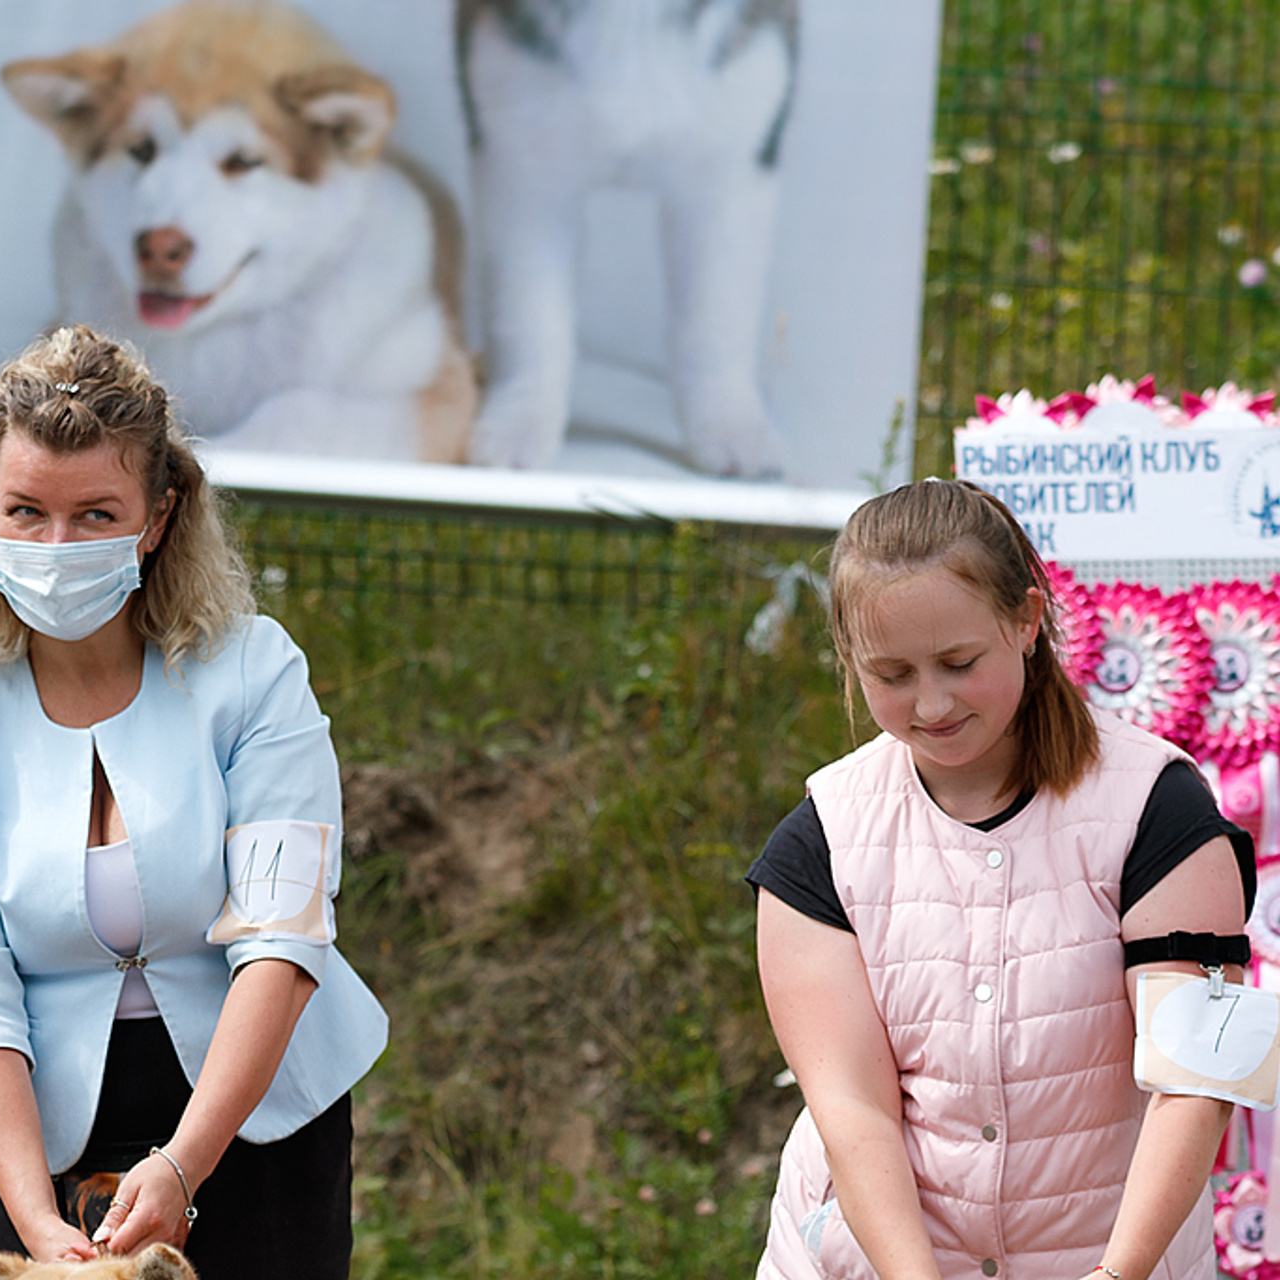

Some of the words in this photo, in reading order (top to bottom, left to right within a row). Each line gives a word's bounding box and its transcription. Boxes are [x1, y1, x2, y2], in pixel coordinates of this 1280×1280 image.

[962, 434, 1134, 476] РЫБИНСКИЙ
[1140, 439, 1222, 474] КЛУБ
[237, 838, 285, 908] 11
